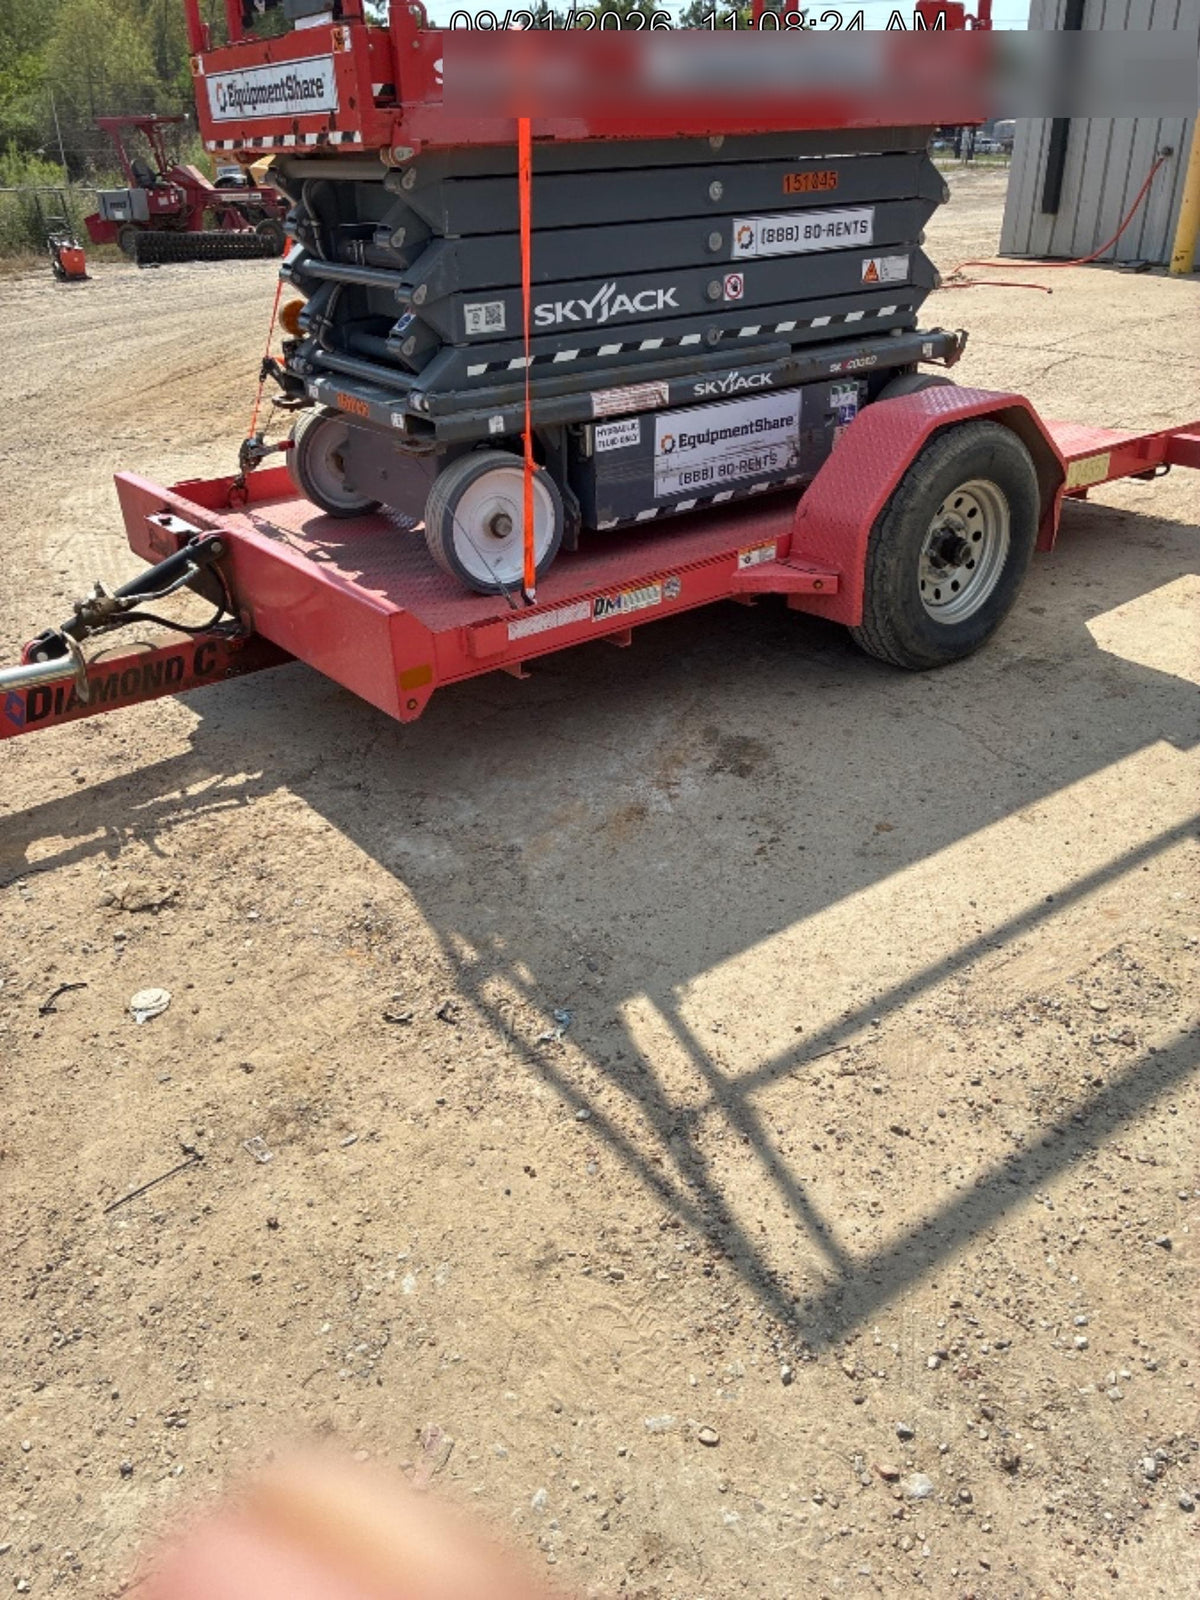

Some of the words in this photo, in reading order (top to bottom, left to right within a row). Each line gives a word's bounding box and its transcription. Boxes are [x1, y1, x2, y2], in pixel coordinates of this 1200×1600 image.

[227, 75, 324, 111] EquipmentShare
[534, 281, 680, 327] SKYJACK
[693, 371, 774, 397] SKYJACK
[678, 415, 795, 450] EquipmentShare
[26, 655, 184, 723] DIAMOND
[193, 641, 217, 676] C
